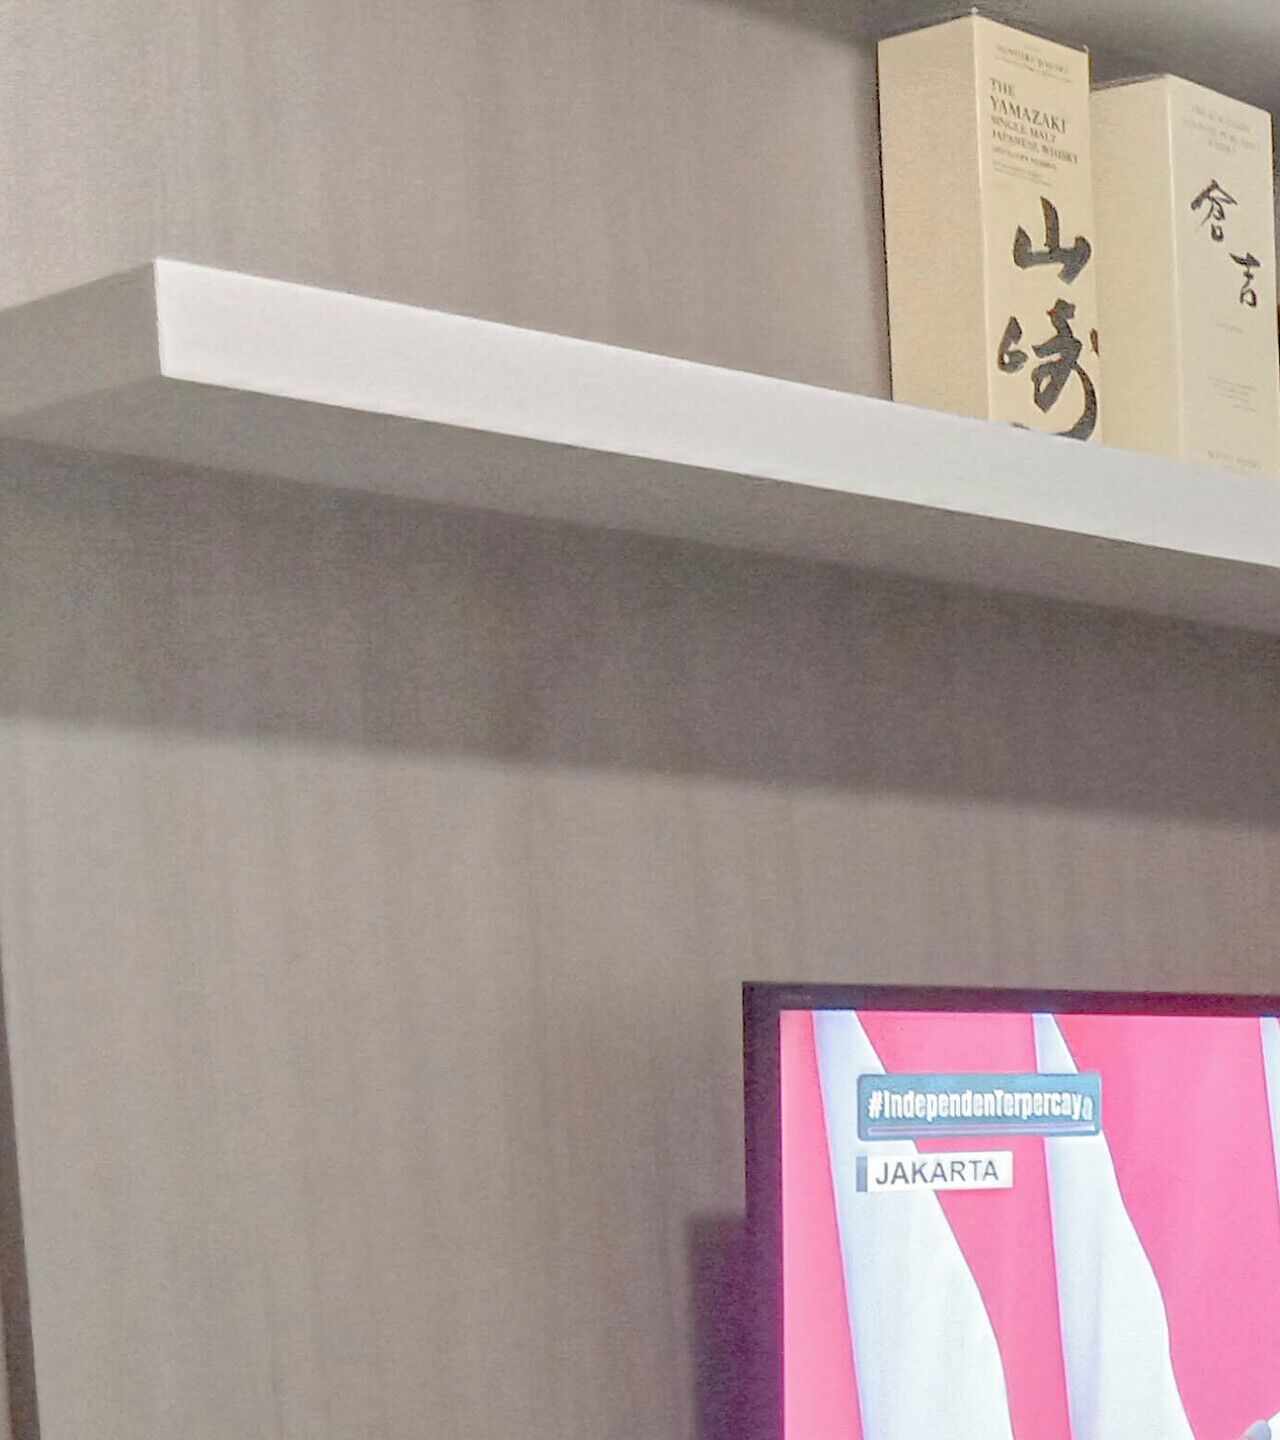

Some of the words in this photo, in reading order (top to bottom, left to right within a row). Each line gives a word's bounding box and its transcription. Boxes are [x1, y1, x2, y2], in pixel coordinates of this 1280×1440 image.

[990, 77, 1015, 96] THE
[990, 95, 1066, 134] YAMAZAKI
[875, 1160, 999, 1185] JAKARTA
